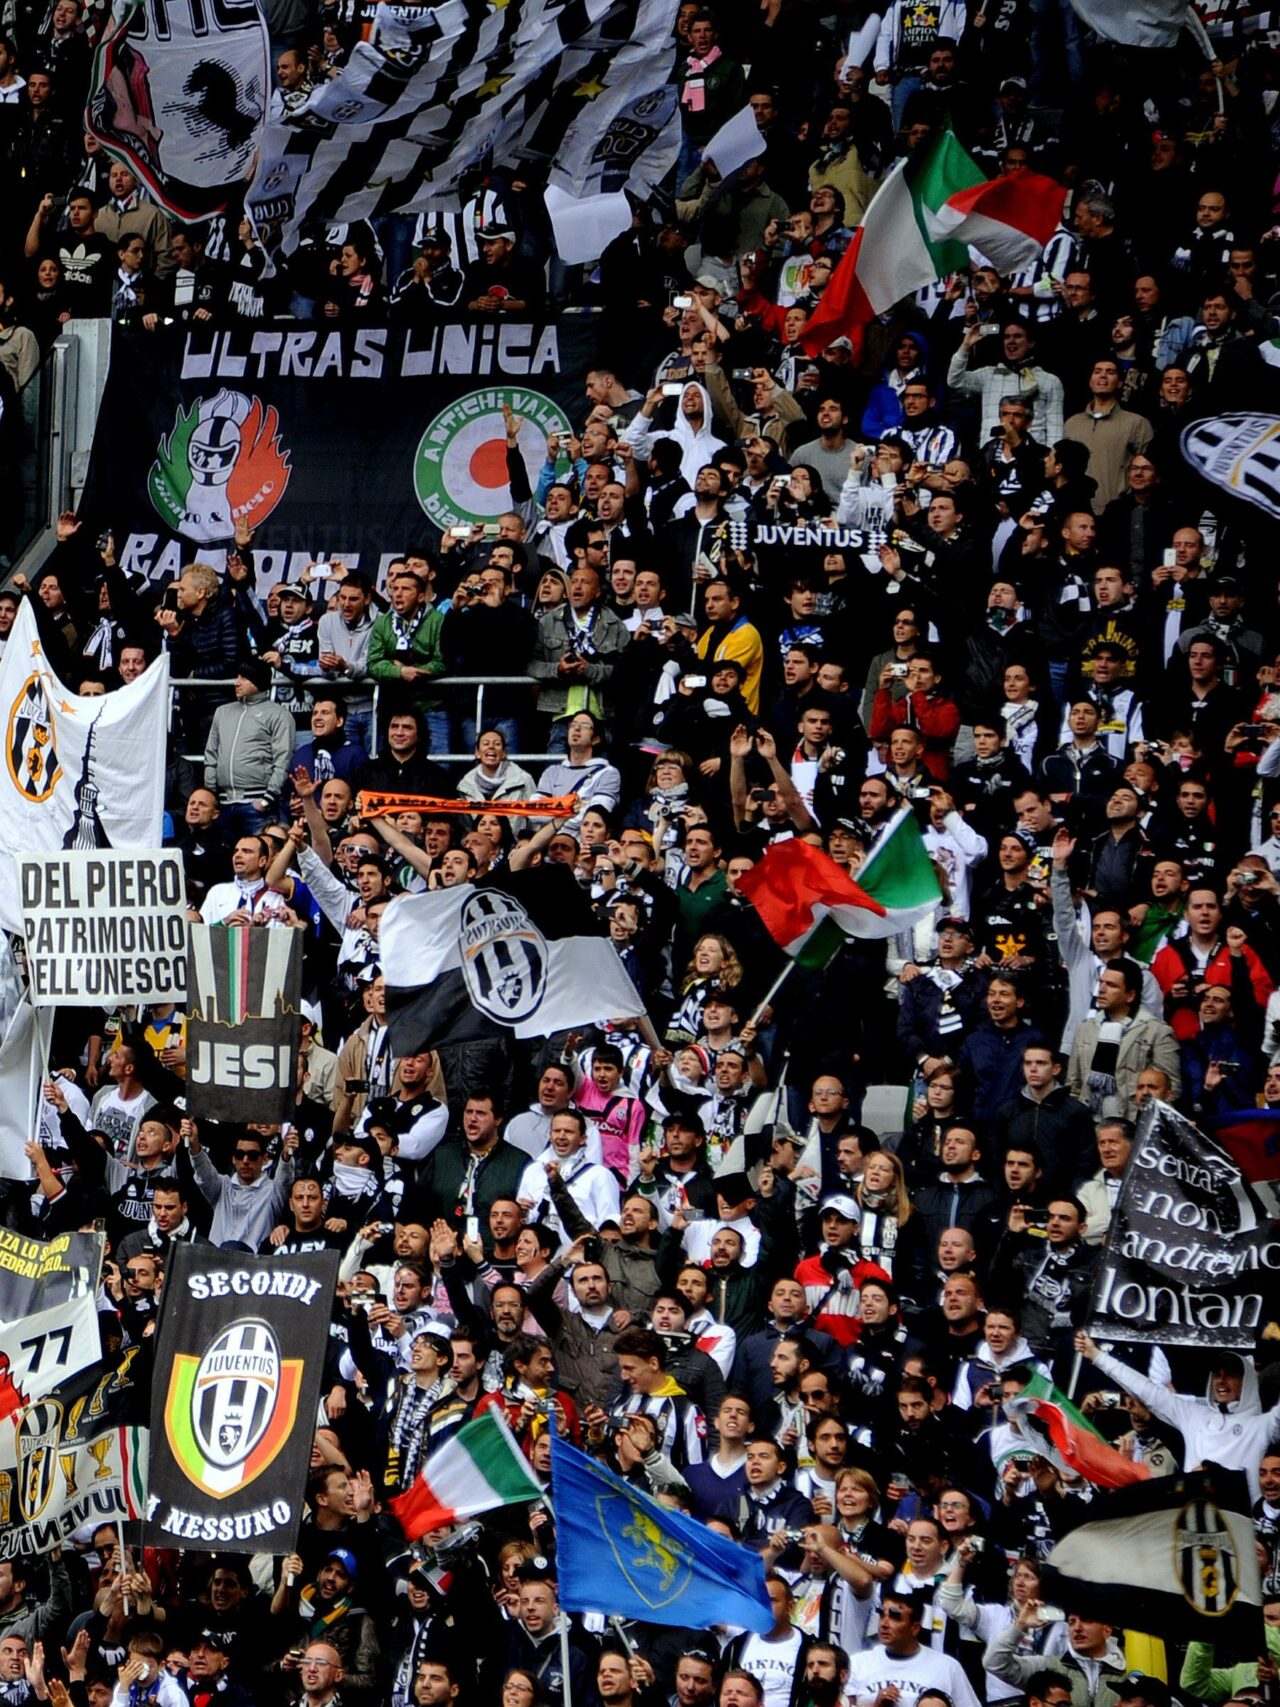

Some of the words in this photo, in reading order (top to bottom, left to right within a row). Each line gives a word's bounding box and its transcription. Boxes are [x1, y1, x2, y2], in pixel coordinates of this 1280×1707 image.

[180, 327, 388, 380] ULTRAS
[753, 524, 864, 548] JUVENTUS
[21, 860, 82, 910] DEL
[86, 859, 181, 909] PIERO
[24, 914, 186, 956] PATRIMONIO
[190, 1039, 292, 1090] JESI
[21, 1239, 40, 1259] LO
[188, 1270, 322, 1305] SECONDI
[20, 1325, 74, 1373] 77
[206, 1354, 274, 1377] JUVENTUS
[161, 1500, 292, 1542] NESSUNO
